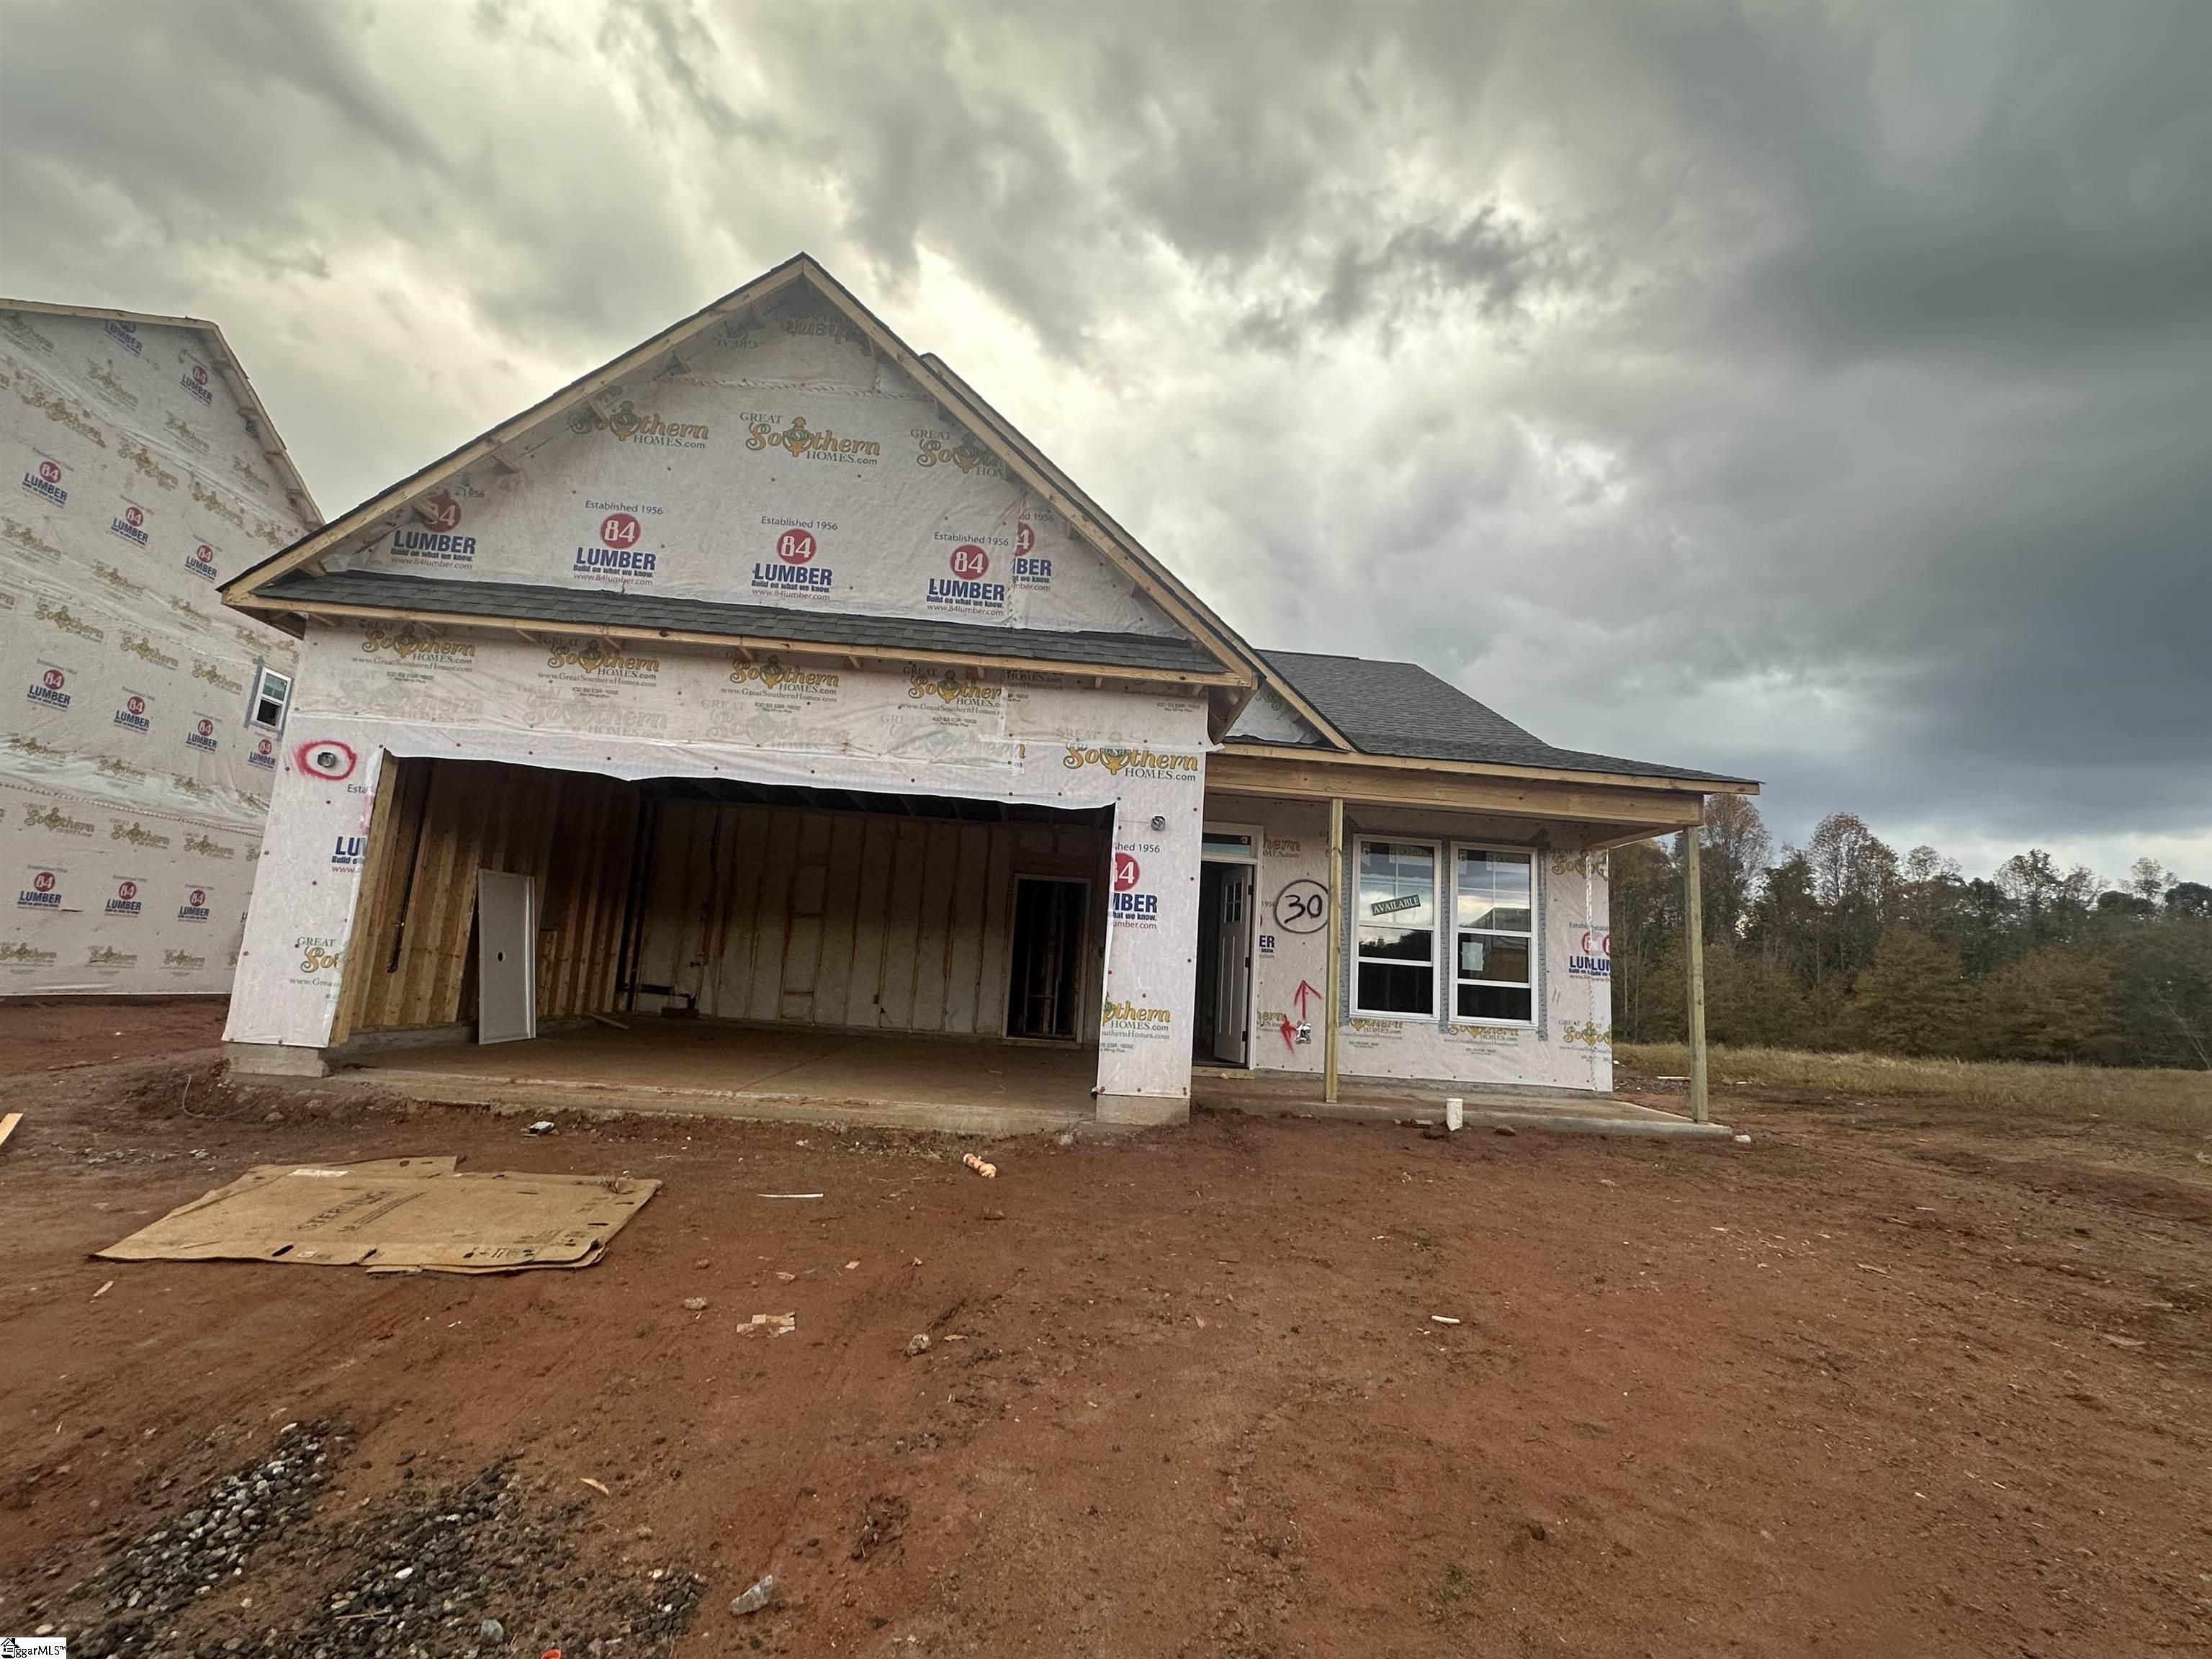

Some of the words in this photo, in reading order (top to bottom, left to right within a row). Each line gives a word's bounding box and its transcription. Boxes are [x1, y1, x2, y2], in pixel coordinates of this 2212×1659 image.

[739, 412, 783, 423] GREAT
[911, 428, 950, 440] GREAT
[806, 451, 877, 464] HOMES.com
[24, 473, 68, 501] LUMBER
[585, 500, 638, 512] Established
[642, 505, 663, 514] 1956
[113, 518, 148, 542] LUMBER
[761, 516, 813, 528] Established
[817, 521, 838, 530] 1956
[604, 520, 635, 542] 84
[394, 530, 476, 554] LUMBER
[934, 532, 985, 544] Established
[989, 537, 1009, 546] 1956
[781, 536, 811, 558] 84
[576, 547, 656, 570] LUMBER
[954, 552, 984, 573] 84
[754, 563, 832, 585] LUMBER
[1013, 558, 1051, 576] BER
[574, 573, 653, 585] www.84lumber.com
[752, 589, 830, 601] www.84lumber.com
[929, 578, 1004, 601] LUMBER
[927, 604, 1003, 616] www.84lumber.com
[413, 652, 472, 665] HOMES.com
[598, 667, 656, 680] HOMES.com
[29, 685, 71, 705] LUMBER
[779, 683, 837, 695] HOMES.com
[116, 711, 149, 728] LUMBER
[188, 732, 217, 748] LUMBER
[1125, 768, 1196, 781] HOMES.com
[1138, 844, 1160, 853] 1956
[19, 891, 62, 904] LUMBER
[107, 899, 142, 911] LUMBER
[1285, 894, 1323, 923] 30
[1373, 896, 1420, 914] AVAILABLE
[297, 937, 336, 947] GREAT
[1110, 1020, 1169, 1031] HOMES.com
